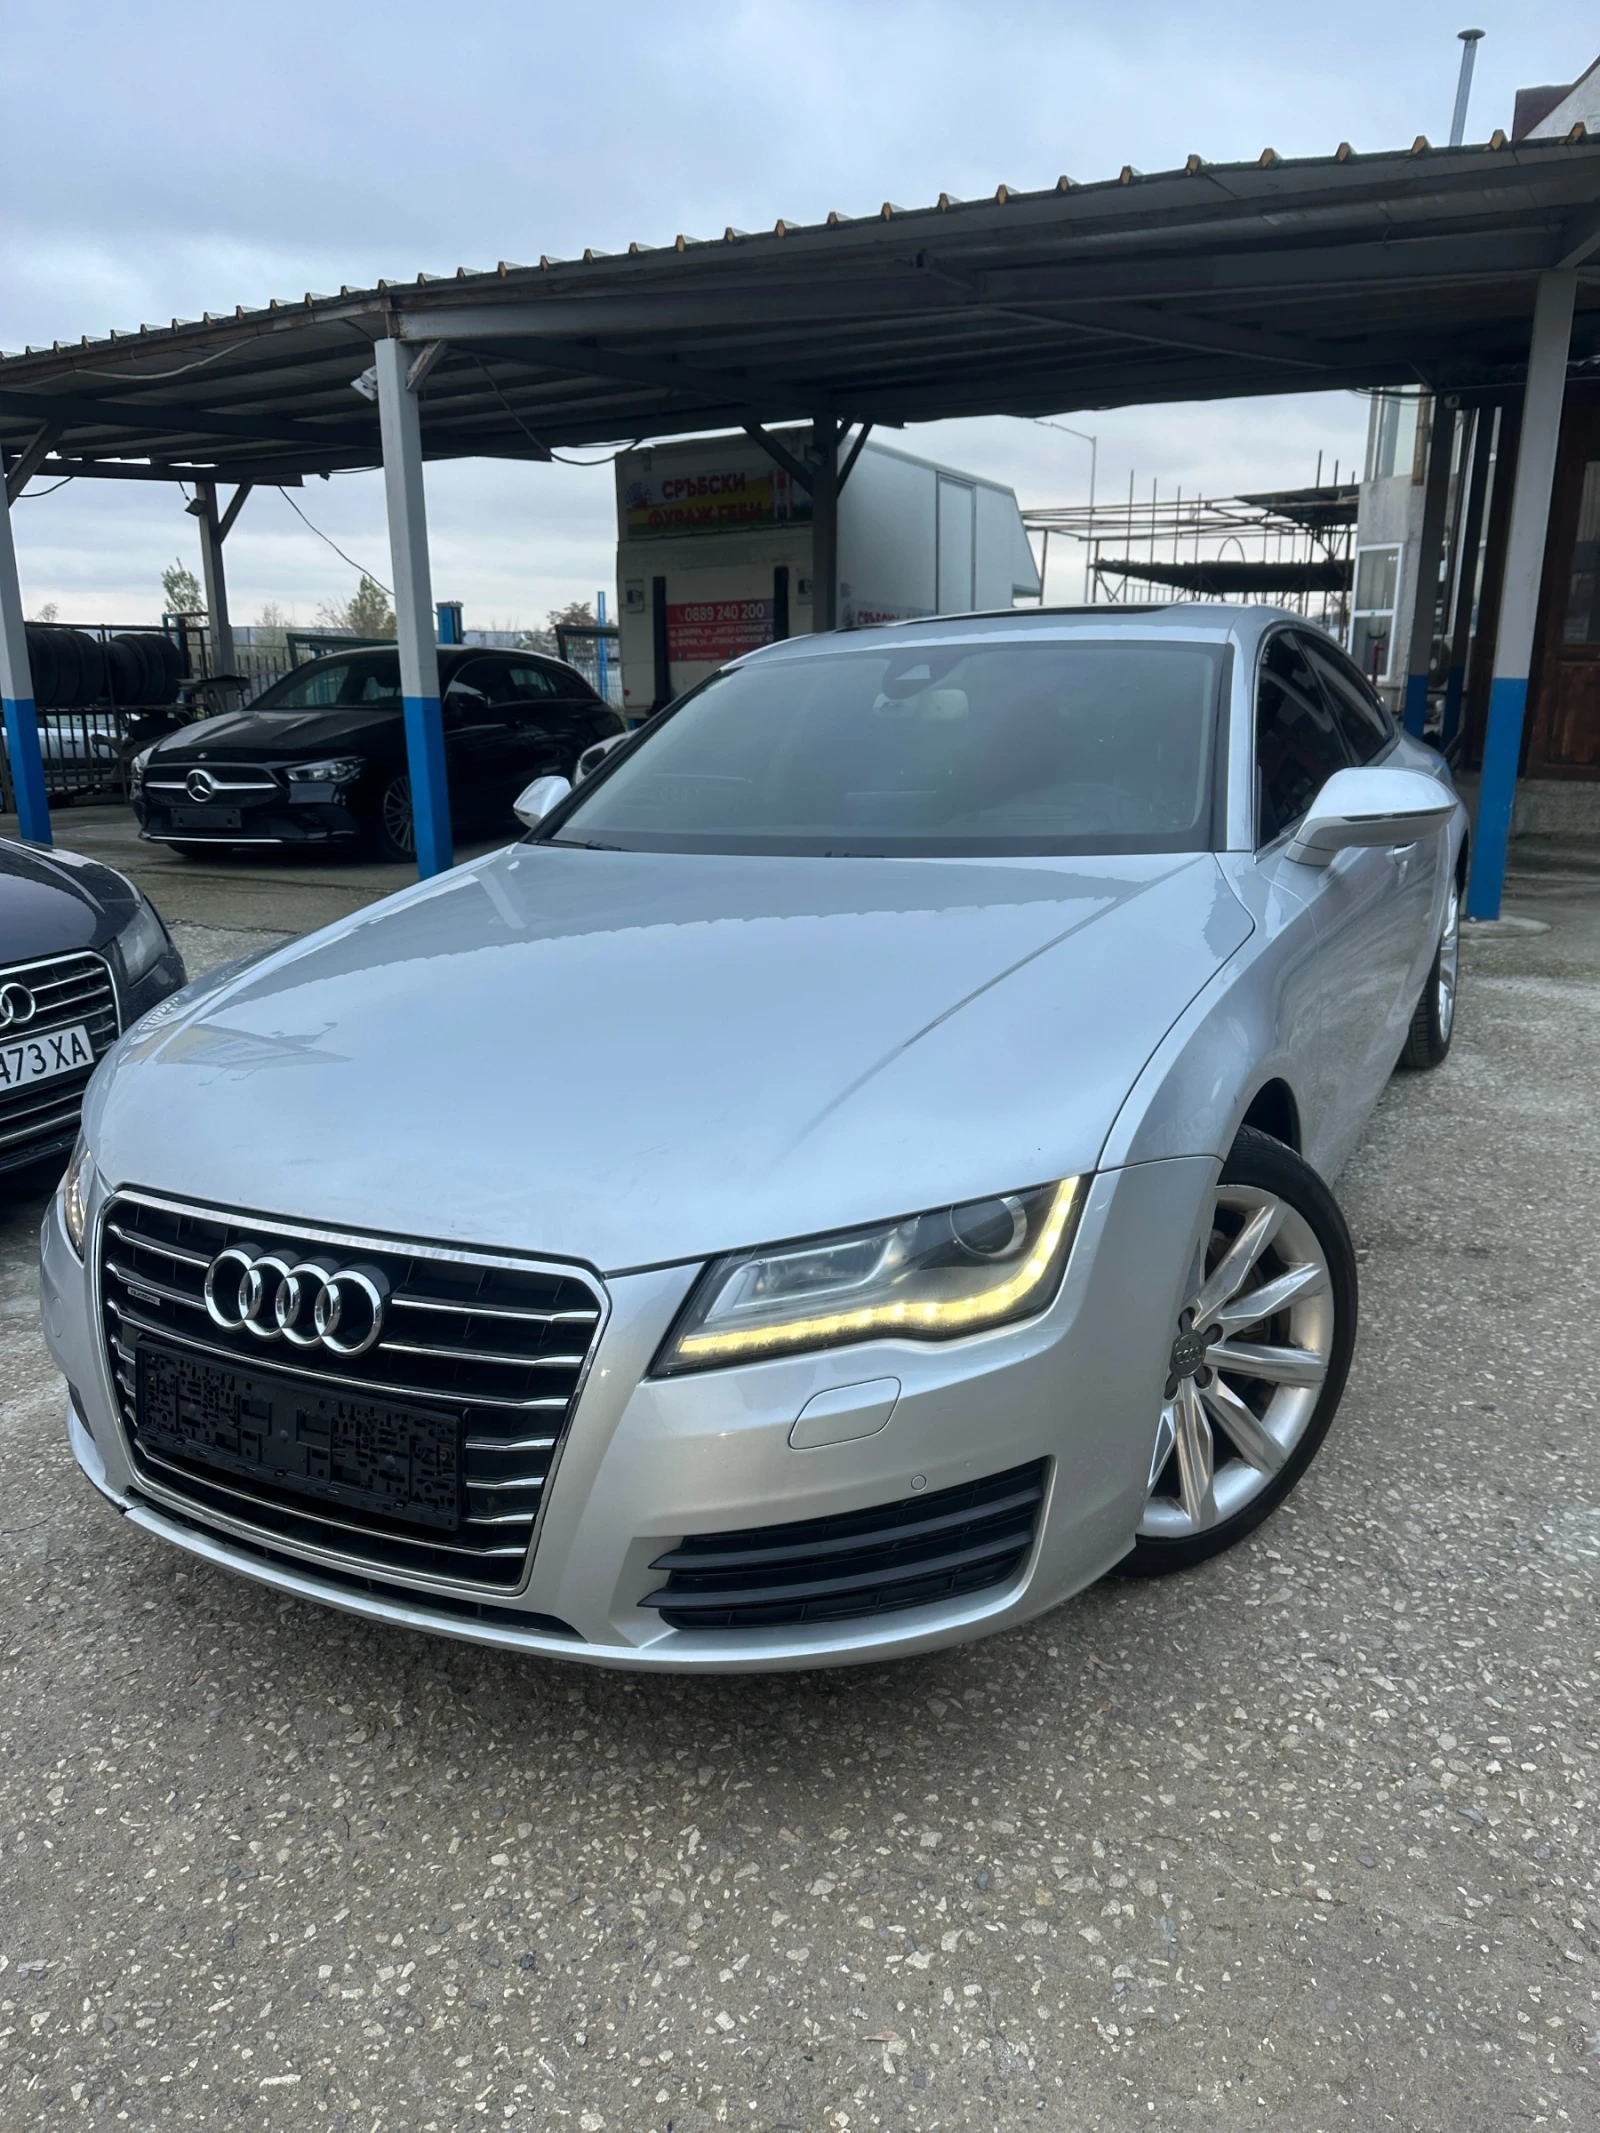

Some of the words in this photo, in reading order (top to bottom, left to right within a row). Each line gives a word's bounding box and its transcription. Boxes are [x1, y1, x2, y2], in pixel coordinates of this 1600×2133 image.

[661, 472, 746, 500] СРЪБСКИ
[648, 506, 714, 532] ФУРАЖ
[685, 606, 714, 622] 0889
[717, 604, 739, 621] 240
[741, 603, 765, 620] 200
